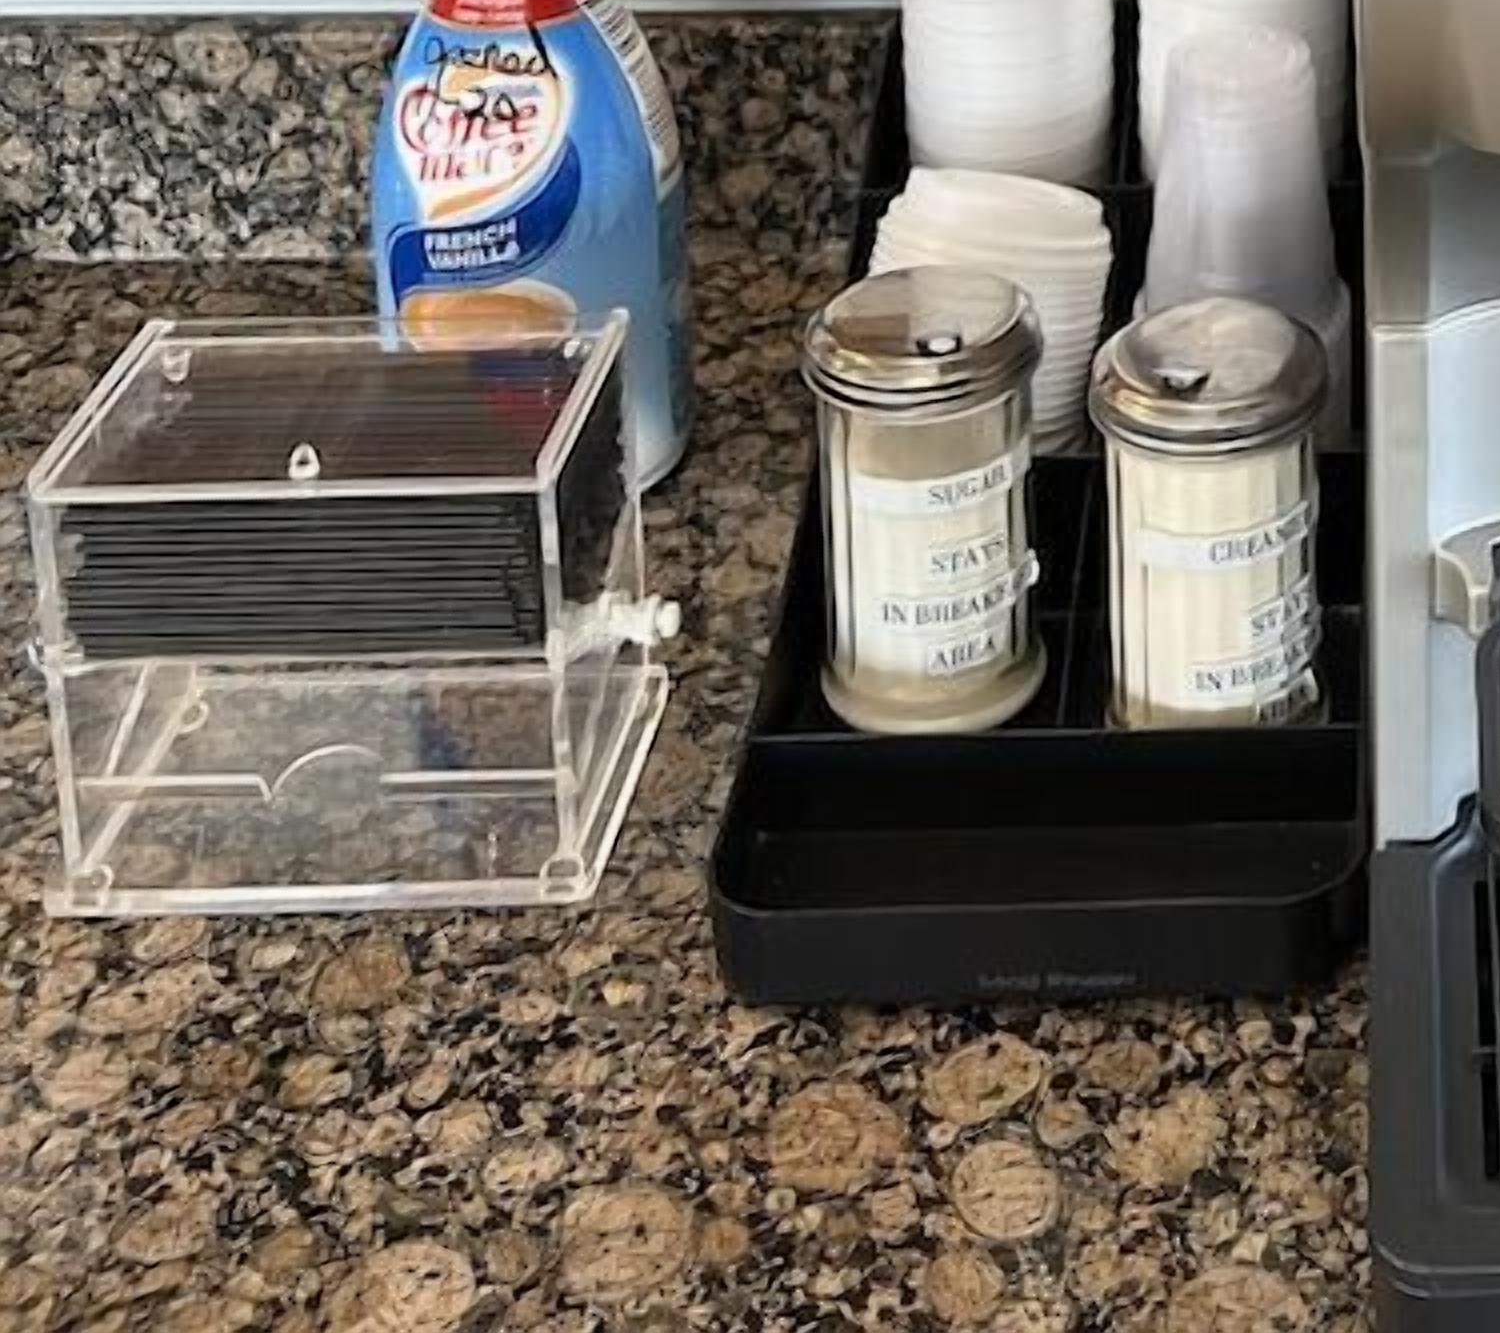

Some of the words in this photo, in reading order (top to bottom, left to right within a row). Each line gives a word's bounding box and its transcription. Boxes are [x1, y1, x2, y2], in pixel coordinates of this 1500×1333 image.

[424, 217, 517, 250] FRENCH
[883, 602, 907, 623] IN
[1195, 668, 1222, 691] IN
